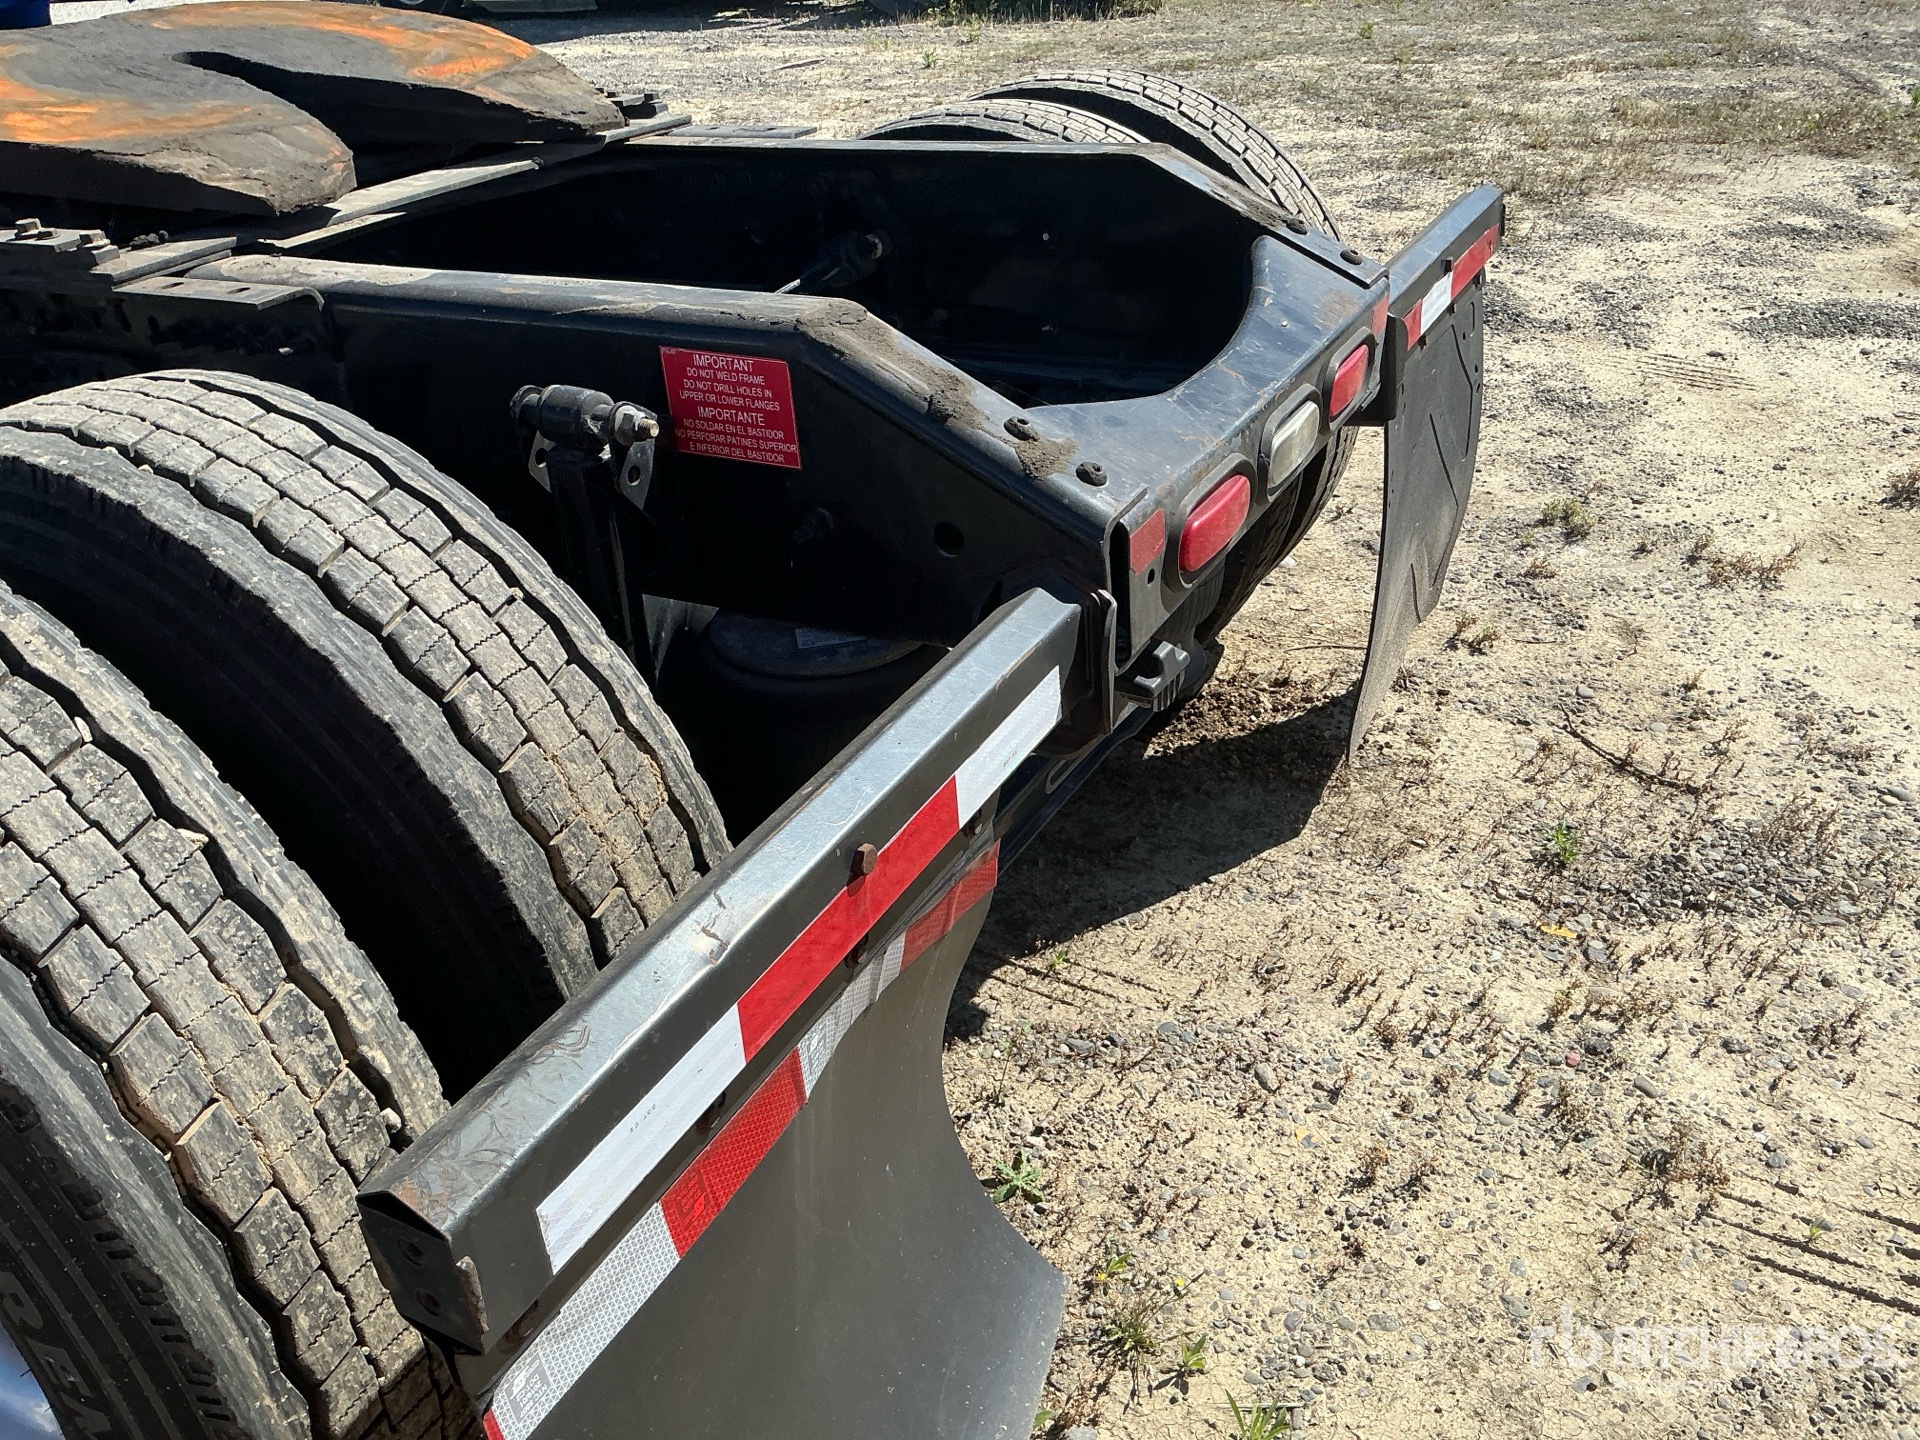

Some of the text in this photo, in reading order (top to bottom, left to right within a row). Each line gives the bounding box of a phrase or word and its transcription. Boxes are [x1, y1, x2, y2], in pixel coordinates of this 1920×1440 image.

[693, 354, 753, 372] IMPORTANT
[687, 367, 765, 385] DO NOT WELD FRAME
[684, 379, 772, 398] DO NOT DRILL HOLES IN
[680, 390, 780, 411] UPPER OR LOWER FLANGES
[697, 406, 765, 426] IMPORTANTE
[683, 419, 784, 440] NO SOLDAR EN EL BASTIDOR
[675, 428, 797, 453] NO PERFORAR PATINES SUPERIOR
[690, 442, 785, 463] E INFERIOR DEL BASTIDOR
